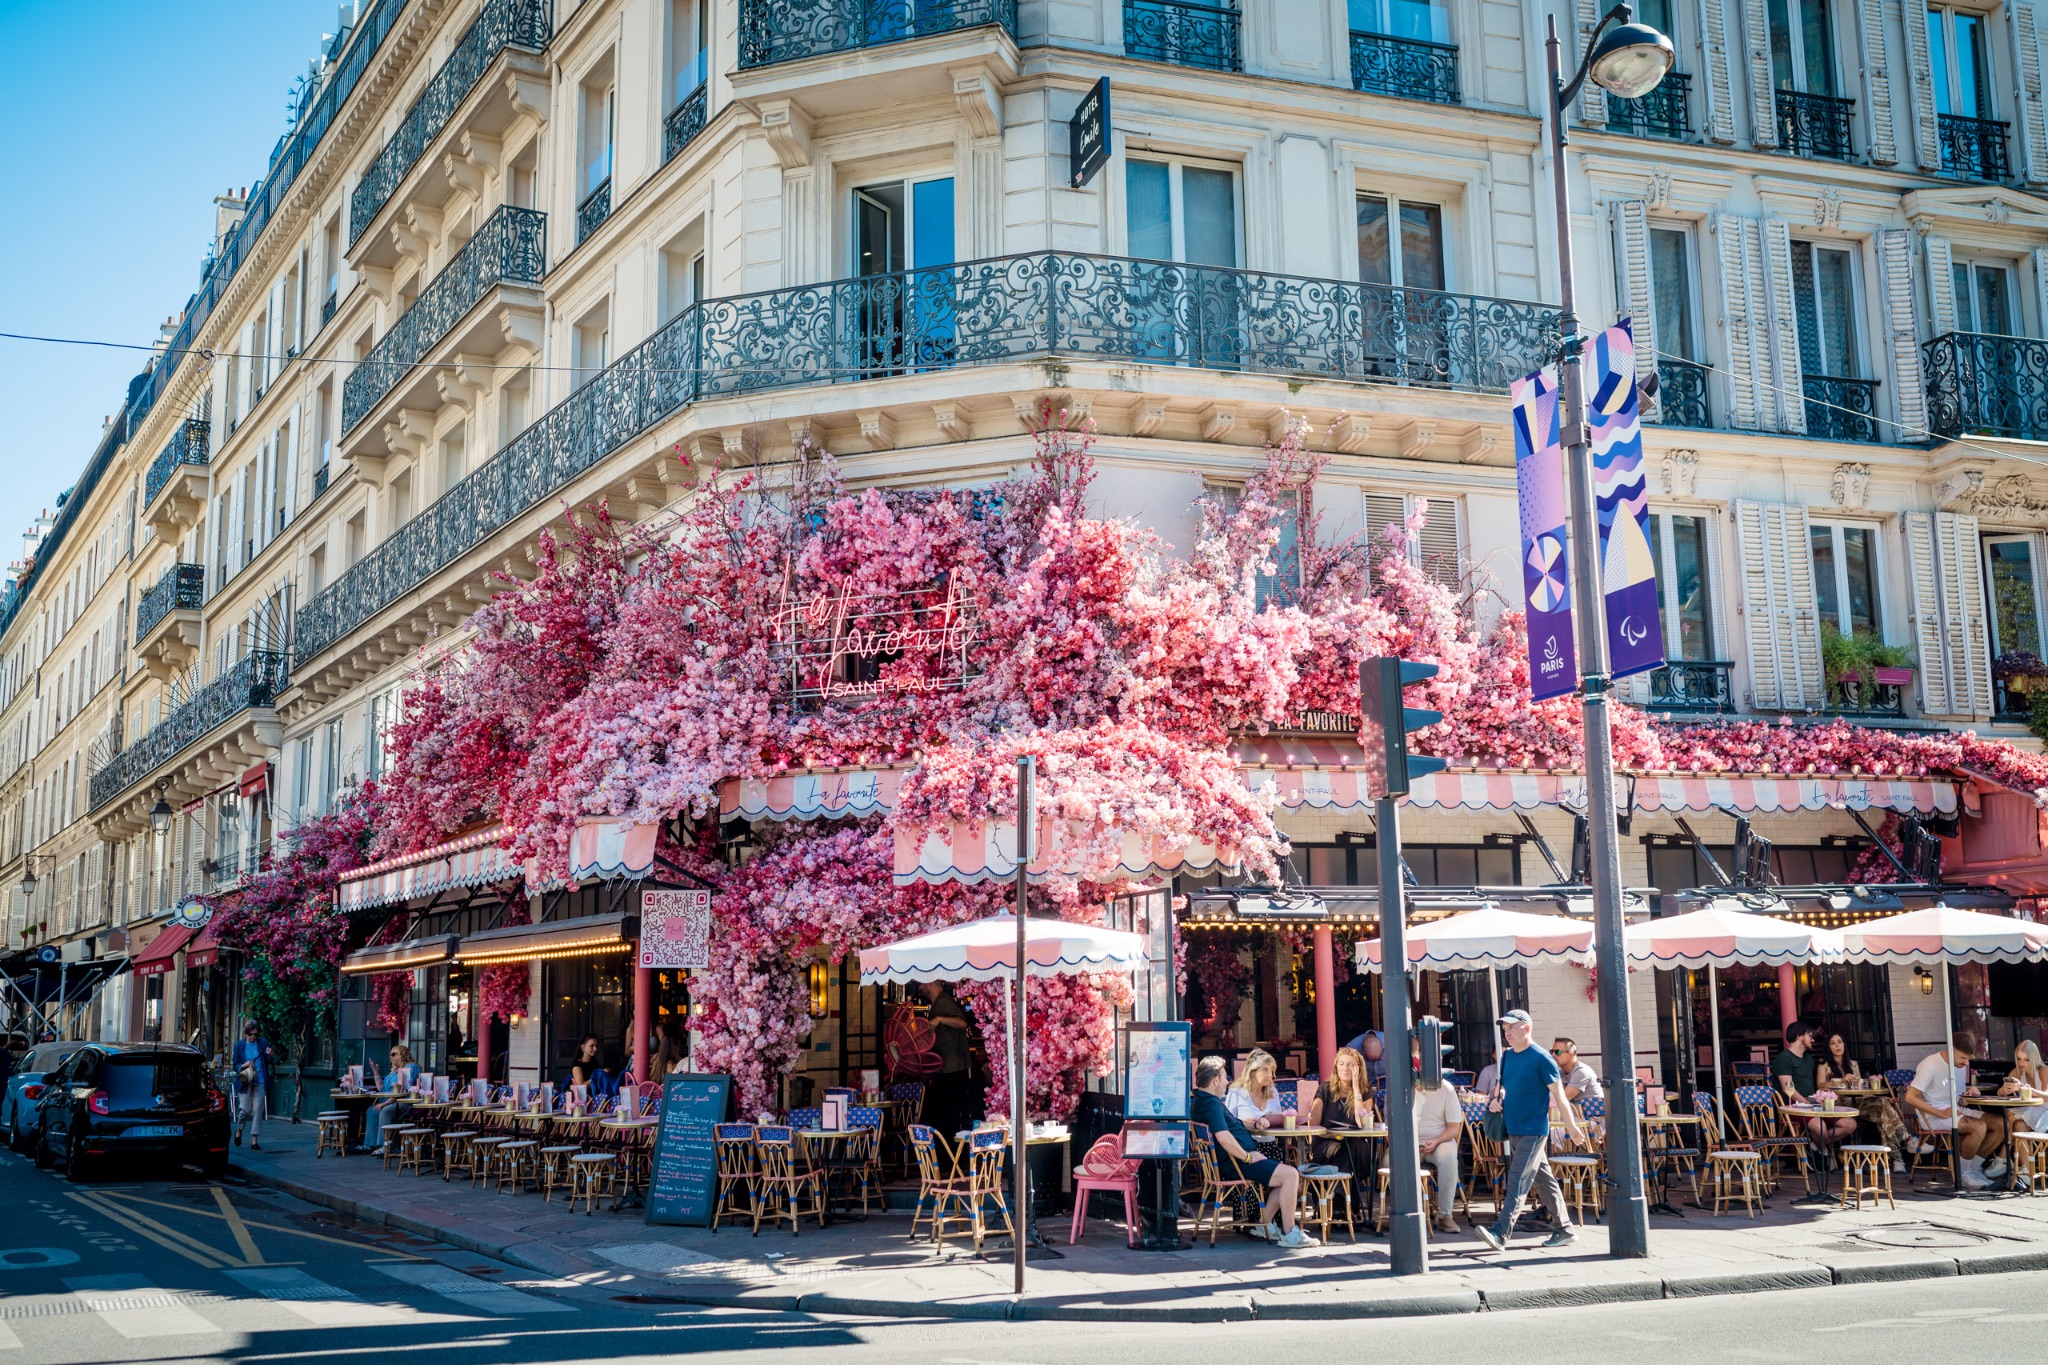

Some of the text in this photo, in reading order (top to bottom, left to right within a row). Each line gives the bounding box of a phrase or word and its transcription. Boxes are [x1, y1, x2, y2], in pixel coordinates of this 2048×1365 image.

[1081, 95, 1099, 125] HOTEL
[1079, 117, 1100, 155] Emile
[770, 552, 834, 642] La
[820, 566, 978, 700] favorite
[1540, 657, 1564, 674] PARIS
[833, 676, 948, 698] SAINT-PAUL
[807, 775, 883, 809] La favorite
[1293, 787, 1339, 795] AINT-PAUL
[1553, 777, 1574, 800] La
[1812, 781, 1831, 804] La
[1835, 780, 1874, 806] favorite
